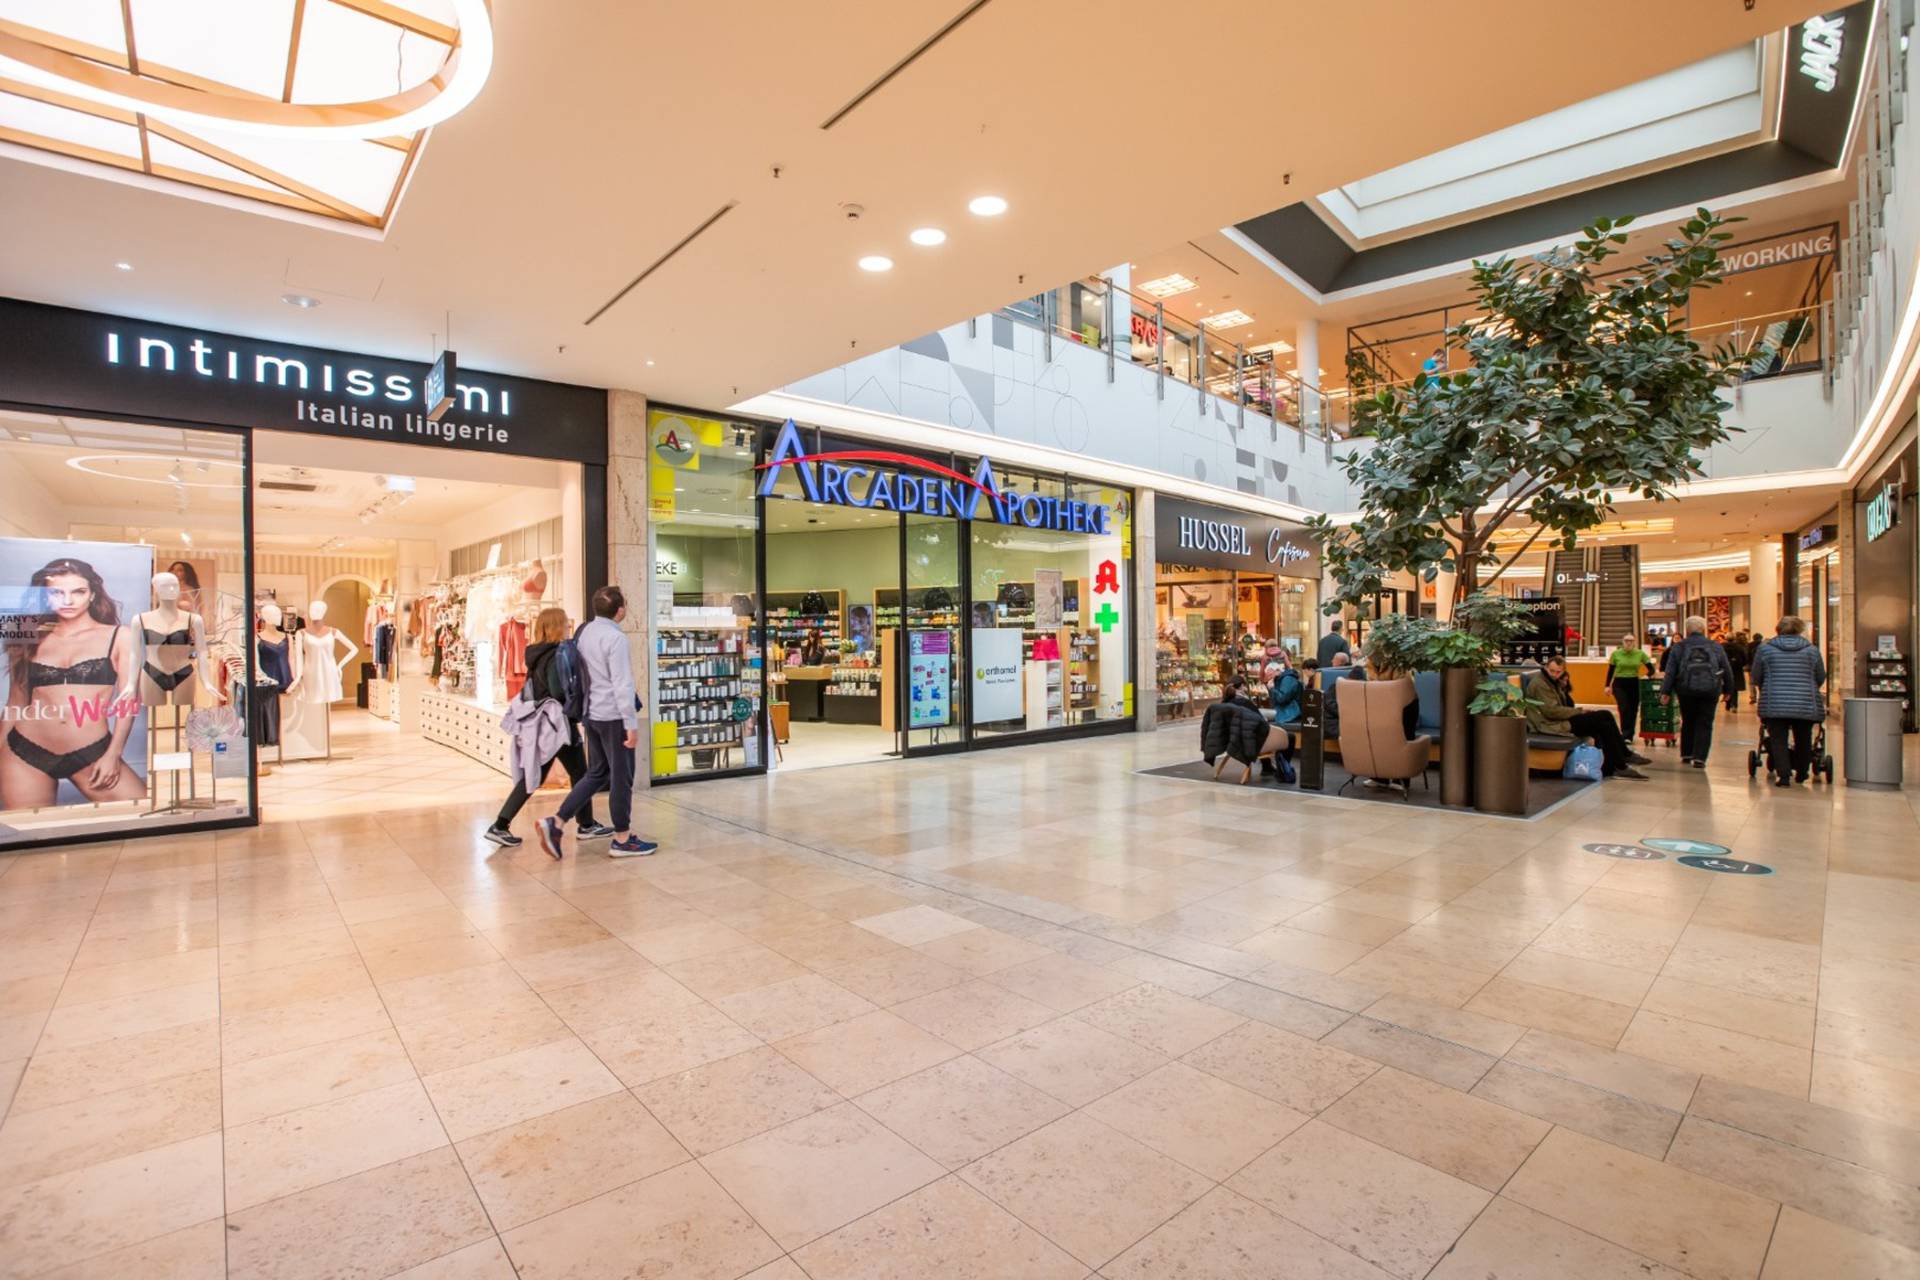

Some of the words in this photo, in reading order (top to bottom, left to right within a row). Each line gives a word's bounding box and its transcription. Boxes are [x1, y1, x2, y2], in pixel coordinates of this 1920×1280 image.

[1800, 15, 1846, 92] JACK
[298, 400, 393, 431] Italian
[406, 413, 509, 443] lingerie
[756, 417, 966, 520] ARCADEN
[1179, 516, 1251, 555] HUSSEL
